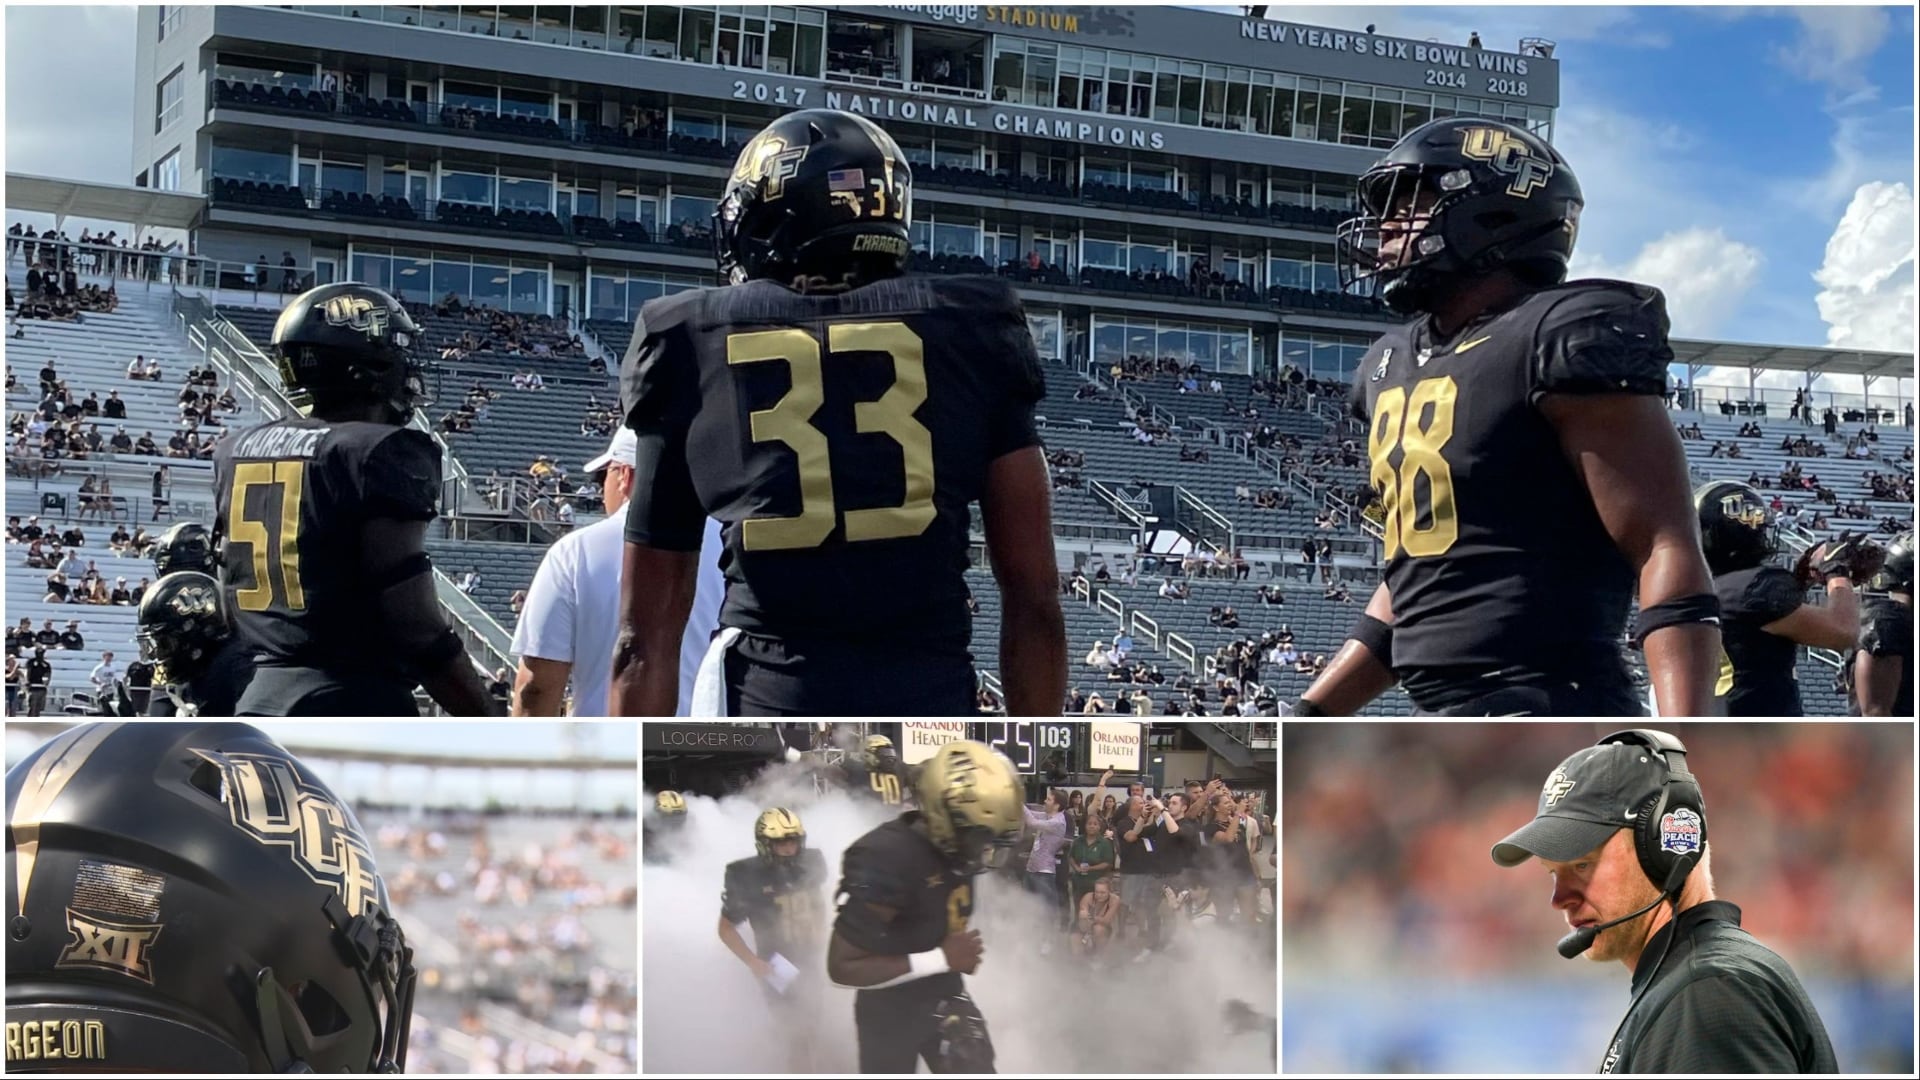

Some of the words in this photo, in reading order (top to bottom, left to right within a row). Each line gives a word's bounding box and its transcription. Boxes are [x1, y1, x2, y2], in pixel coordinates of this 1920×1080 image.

[887, 5, 978, 23] ortgage
[984, 6, 1079, 33] STADIUM
[1241, 21, 1287, 42] NEW
[1293, 28, 1368, 54] YEAR'S
[1374, 39, 1408, 60] SIX
[1415, 46, 1472, 67] BOWL
[1478, 53, 1528, 75] WINS
[1426, 70, 1466, 88] 2014
[1488, 78, 1528, 96] 2018
[733, 81, 806, 105] 2017
[826, 91, 977, 127] NATIONAL
[994, 113, 1165, 149] CHAMPIONS
[1453, 126, 1554, 198] UCF
[314, 294, 389, 342] UCF
[727, 322, 937, 551] 33
[1368, 376, 1458, 560] 88
[229, 461, 305, 611] 51
[661, 731, 729, 746] LOCKER
[733, 733, 768, 747] ROO
[1040, 725, 1071, 749] 103
[1093, 731, 1139, 745] ORLANDO
[1098, 743, 1134, 756] HEALTH
[870, 772, 900, 804] 40
[186, 748, 380, 919] UCF
[1664, 833, 1697, 843] PEACH
